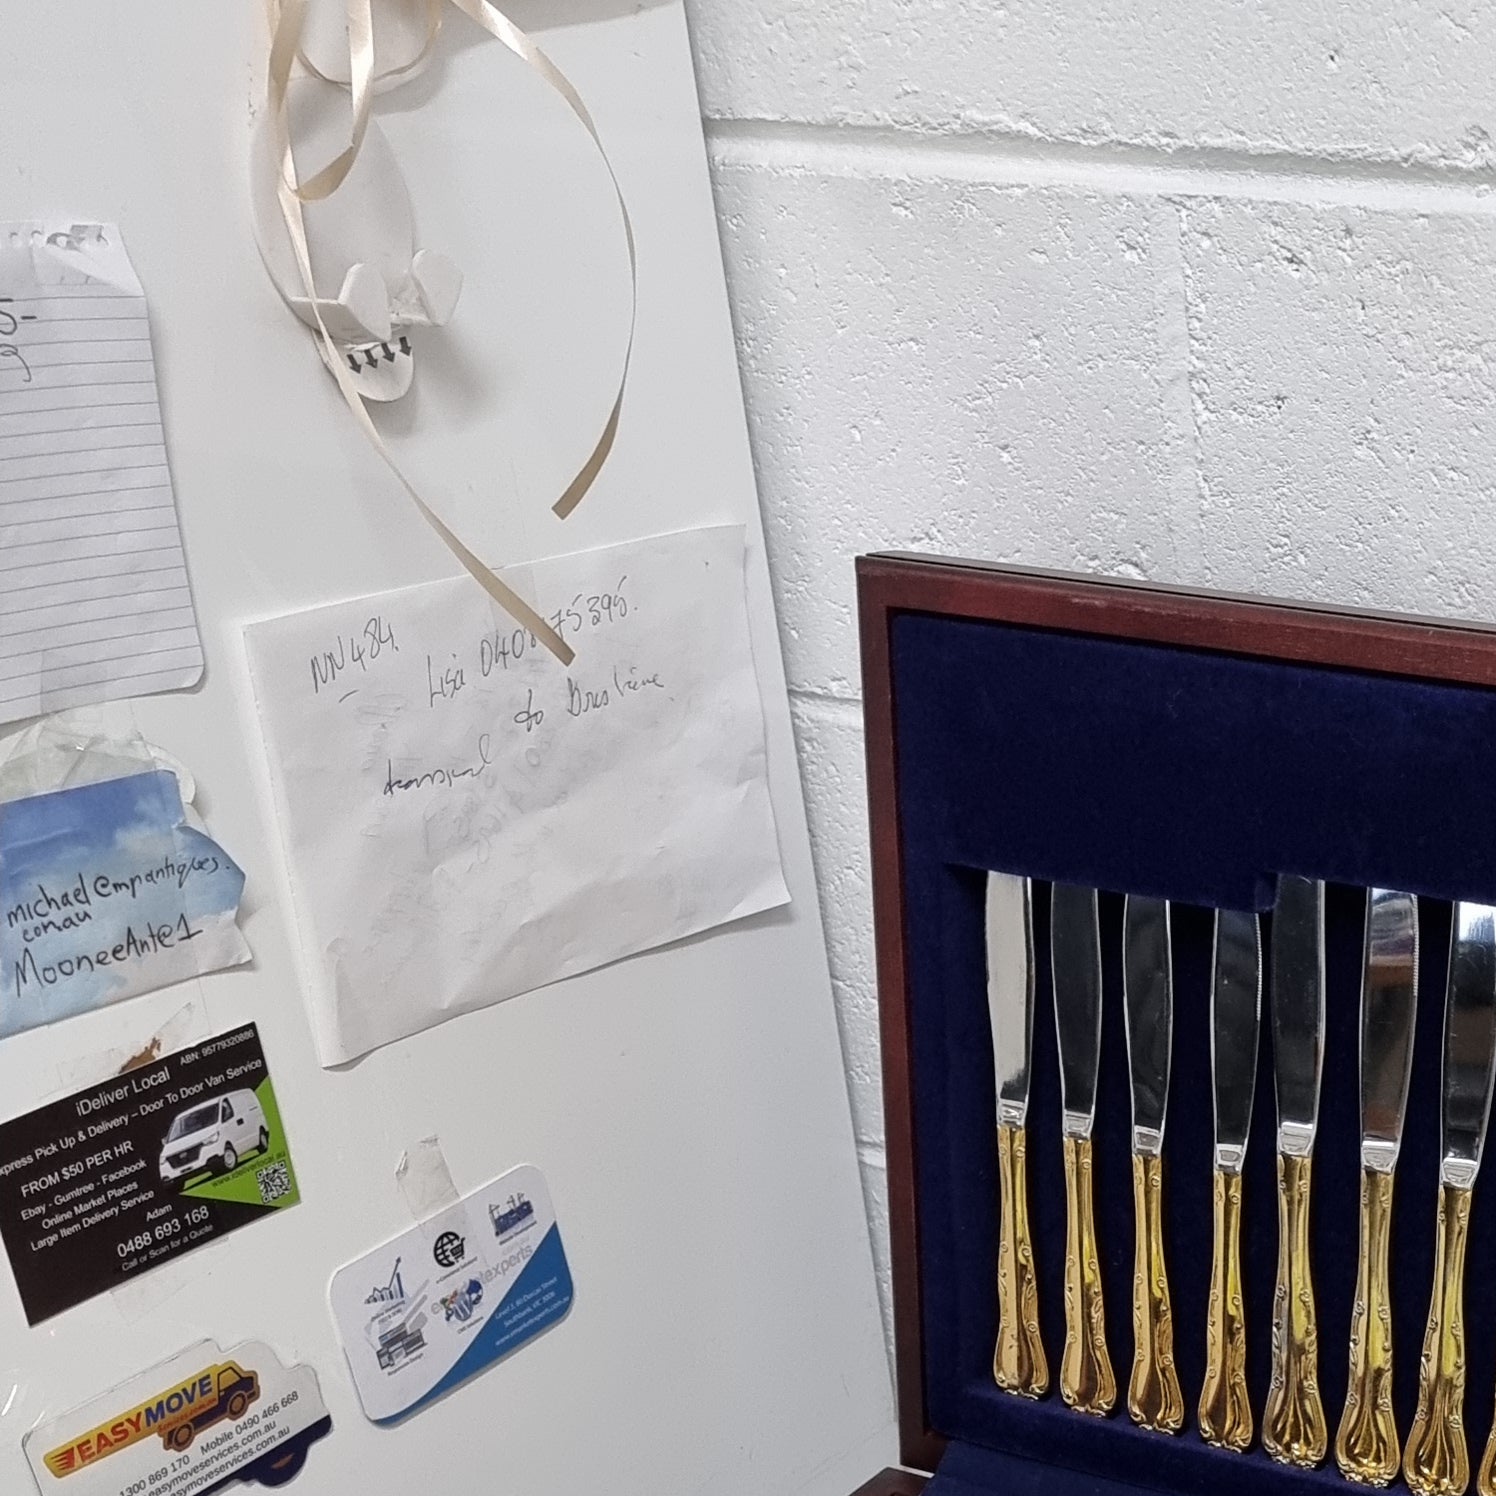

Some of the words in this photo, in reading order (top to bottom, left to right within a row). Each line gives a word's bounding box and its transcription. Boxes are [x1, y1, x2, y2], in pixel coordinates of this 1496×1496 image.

[180, 1050, 200, 1066] ABN:
[34, 1143, 59, 1161] Pick
[59, 1136, 77, 1150] Up
[78, 1130, 87, 1142] &
[88, 1114, 130, 1138] Delivery
[140, 1099, 164, 1116] Door
[165, 1093, 179, 1105] To
[180, 1082, 206, 1099] Door
[205, 1073, 226, 1088] Van
[226, 1058, 262, 1080] Service
[76, 1085, 129, 1117] iDeliver
[132, 1066, 171, 1094] Local
[20, 1204, 47, 1222] Ebay
[53, 1182, 95, 1207] Gumtree
[101, 1159, 148, 1185] Facebook
[21, 1173, 61, 1198] FROM
[62, 1161, 85, 1181] $50
[86, 1149, 114, 1170] PER
[113, 1140, 134, 1157] HR
[30, 1232, 60, 1252] Large
[60, 1220, 82, 1239] Item
[82, 1206, 121, 1229] Delivery
[121, 1190, 155, 1212] Service
[42, 1211, 74, 1230] Online
[75, 1196, 107, 1215] Market
[108, 1181, 139, 1201] Places
[117, 1232, 153, 1258] 0488
[154, 1218, 182, 1240] 693
[184, 1205, 210, 1226] 168
[146, 1204, 173, 1222] Adam
[122, 1257, 139, 1272] Call
[140, 1255, 149, 1264] or
[149, 1244, 170, 1261] Scan
[170, 1237, 182, 1252] for
[182, 1236, 189, 1245] a
[189, 1223, 215, 1241] Quote
[148, 1467, 169, 1486] 869
[170, 1454, 191, 1474] 170
[200, 1431, 235, 1456] Mobile
[235, 1414, 261, 1436] 0490
[262, 1404, 280, 1421] 466
[281, 1391, 299, 1409] 668
